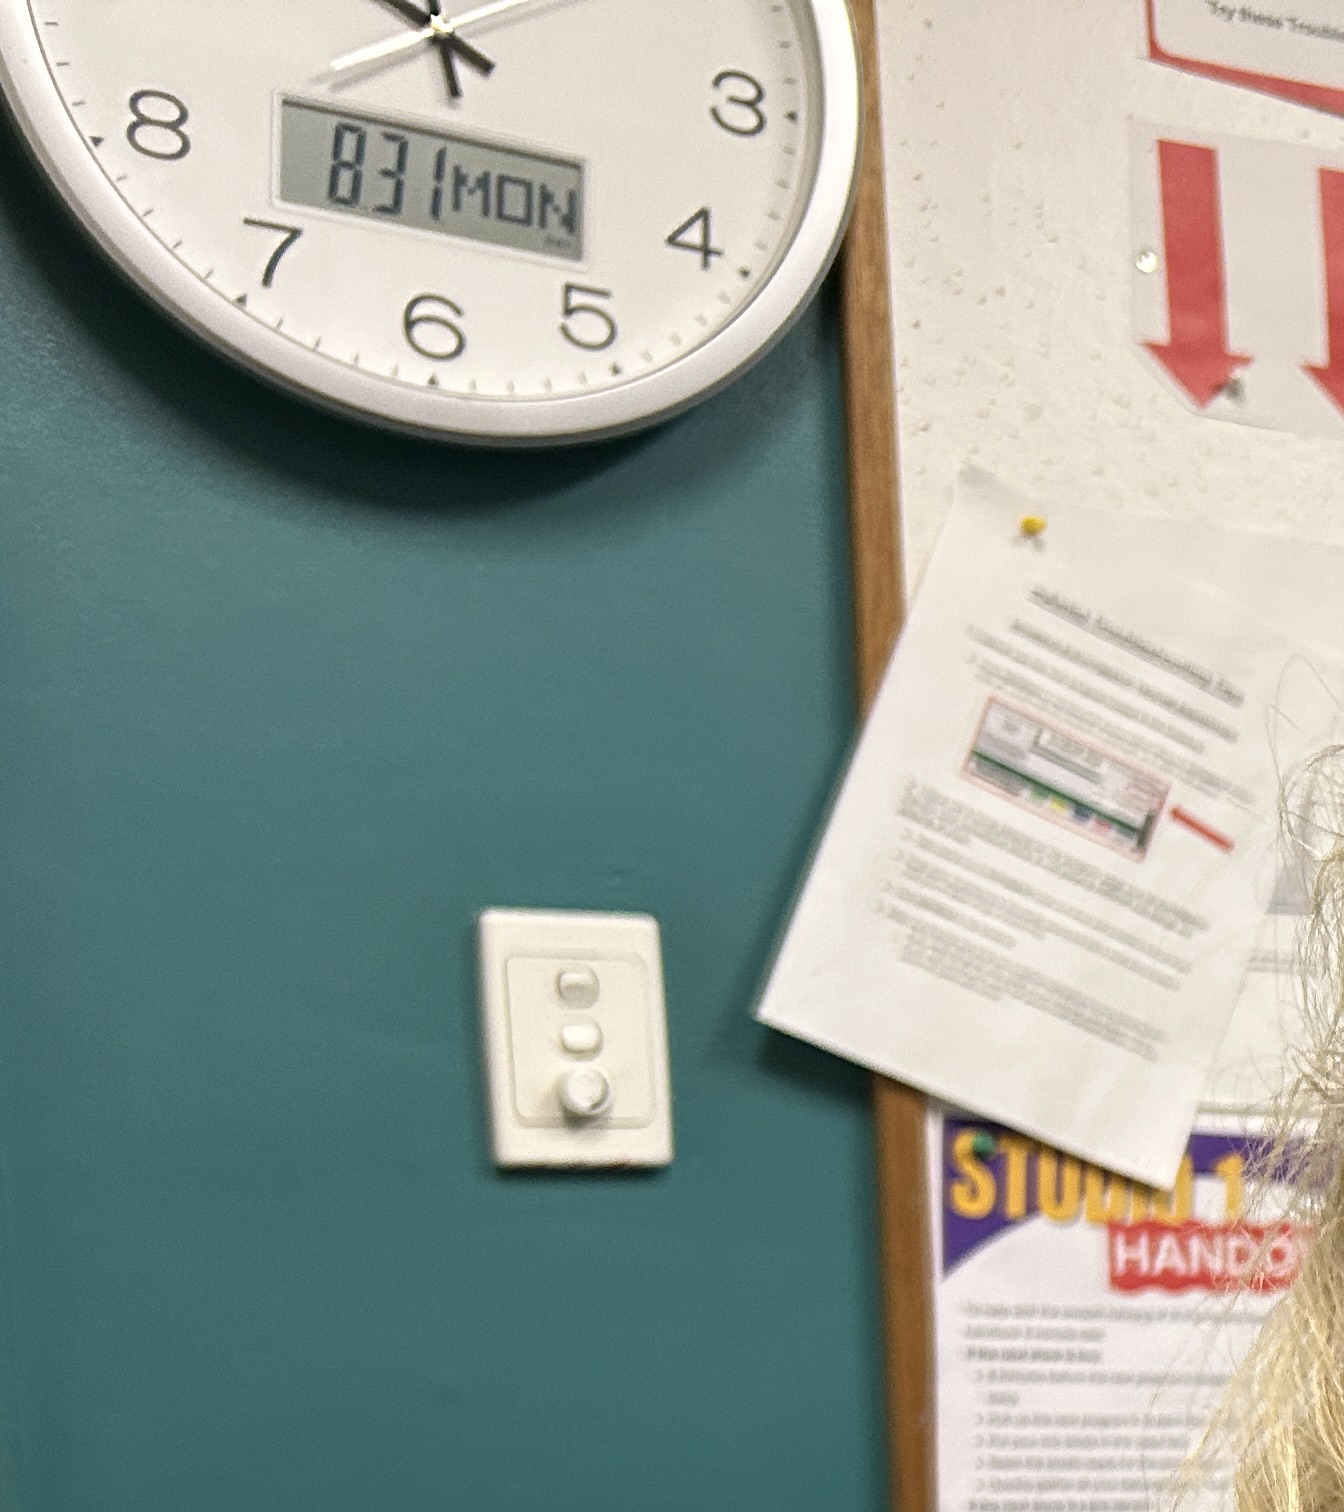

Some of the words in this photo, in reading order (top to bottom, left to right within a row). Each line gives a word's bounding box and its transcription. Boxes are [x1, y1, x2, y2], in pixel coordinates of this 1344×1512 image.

[126, 89, 191, 161] 8
[709, 69, 767, 137] 3
[243, 216, 303, 288] 7
[665, 206, 723, 273] 4
[404, 293, 467, 360] 6
[558, 283, 619, 350] 5
[1215, 1152, 1244, 1225] 1
